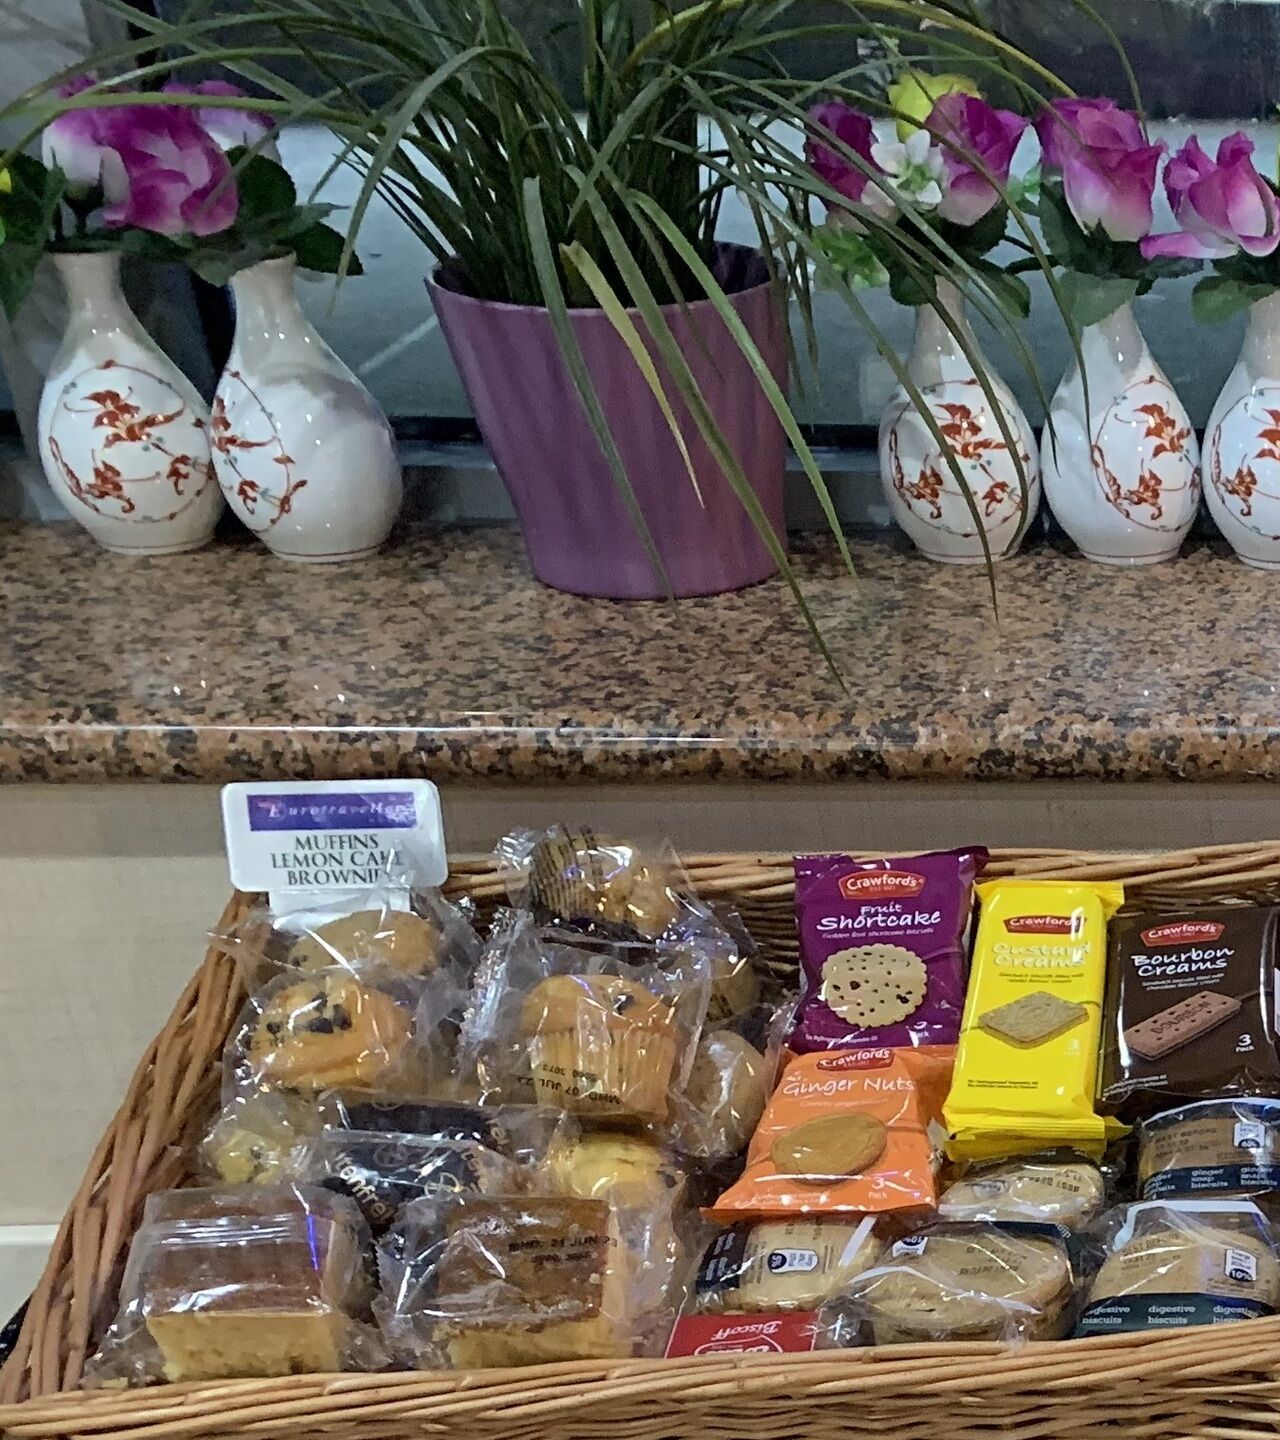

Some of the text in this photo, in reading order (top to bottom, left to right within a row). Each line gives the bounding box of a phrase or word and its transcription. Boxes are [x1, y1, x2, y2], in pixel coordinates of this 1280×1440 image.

[295, 833, 379, 850] MUFFINS
[270, 851, 343, 868] LEMON
[847, 874, 918, 890] Crawford's
[860, 902, 902, 917] Fruit
[816, 911, 941, 930] Shortcake
[1148, 924, 1217, 938] Crawford's
[1131, 948, 1235, 966] Bourbon
[1138, 959, 1227, 976] Creams
[1239, 1034, 1251, 1046] 3
[540, 1079, 561, 1090] JUL
[783, 1077, 915, 1096] Ginger Nuts
[872, 1177, 885, 1189] 3
[1191, 1181, 1228, 1189] biscuits
[1149, 1306, 1195, 1314] digestive
[711, 1321, 782, 1341] Biscoff
